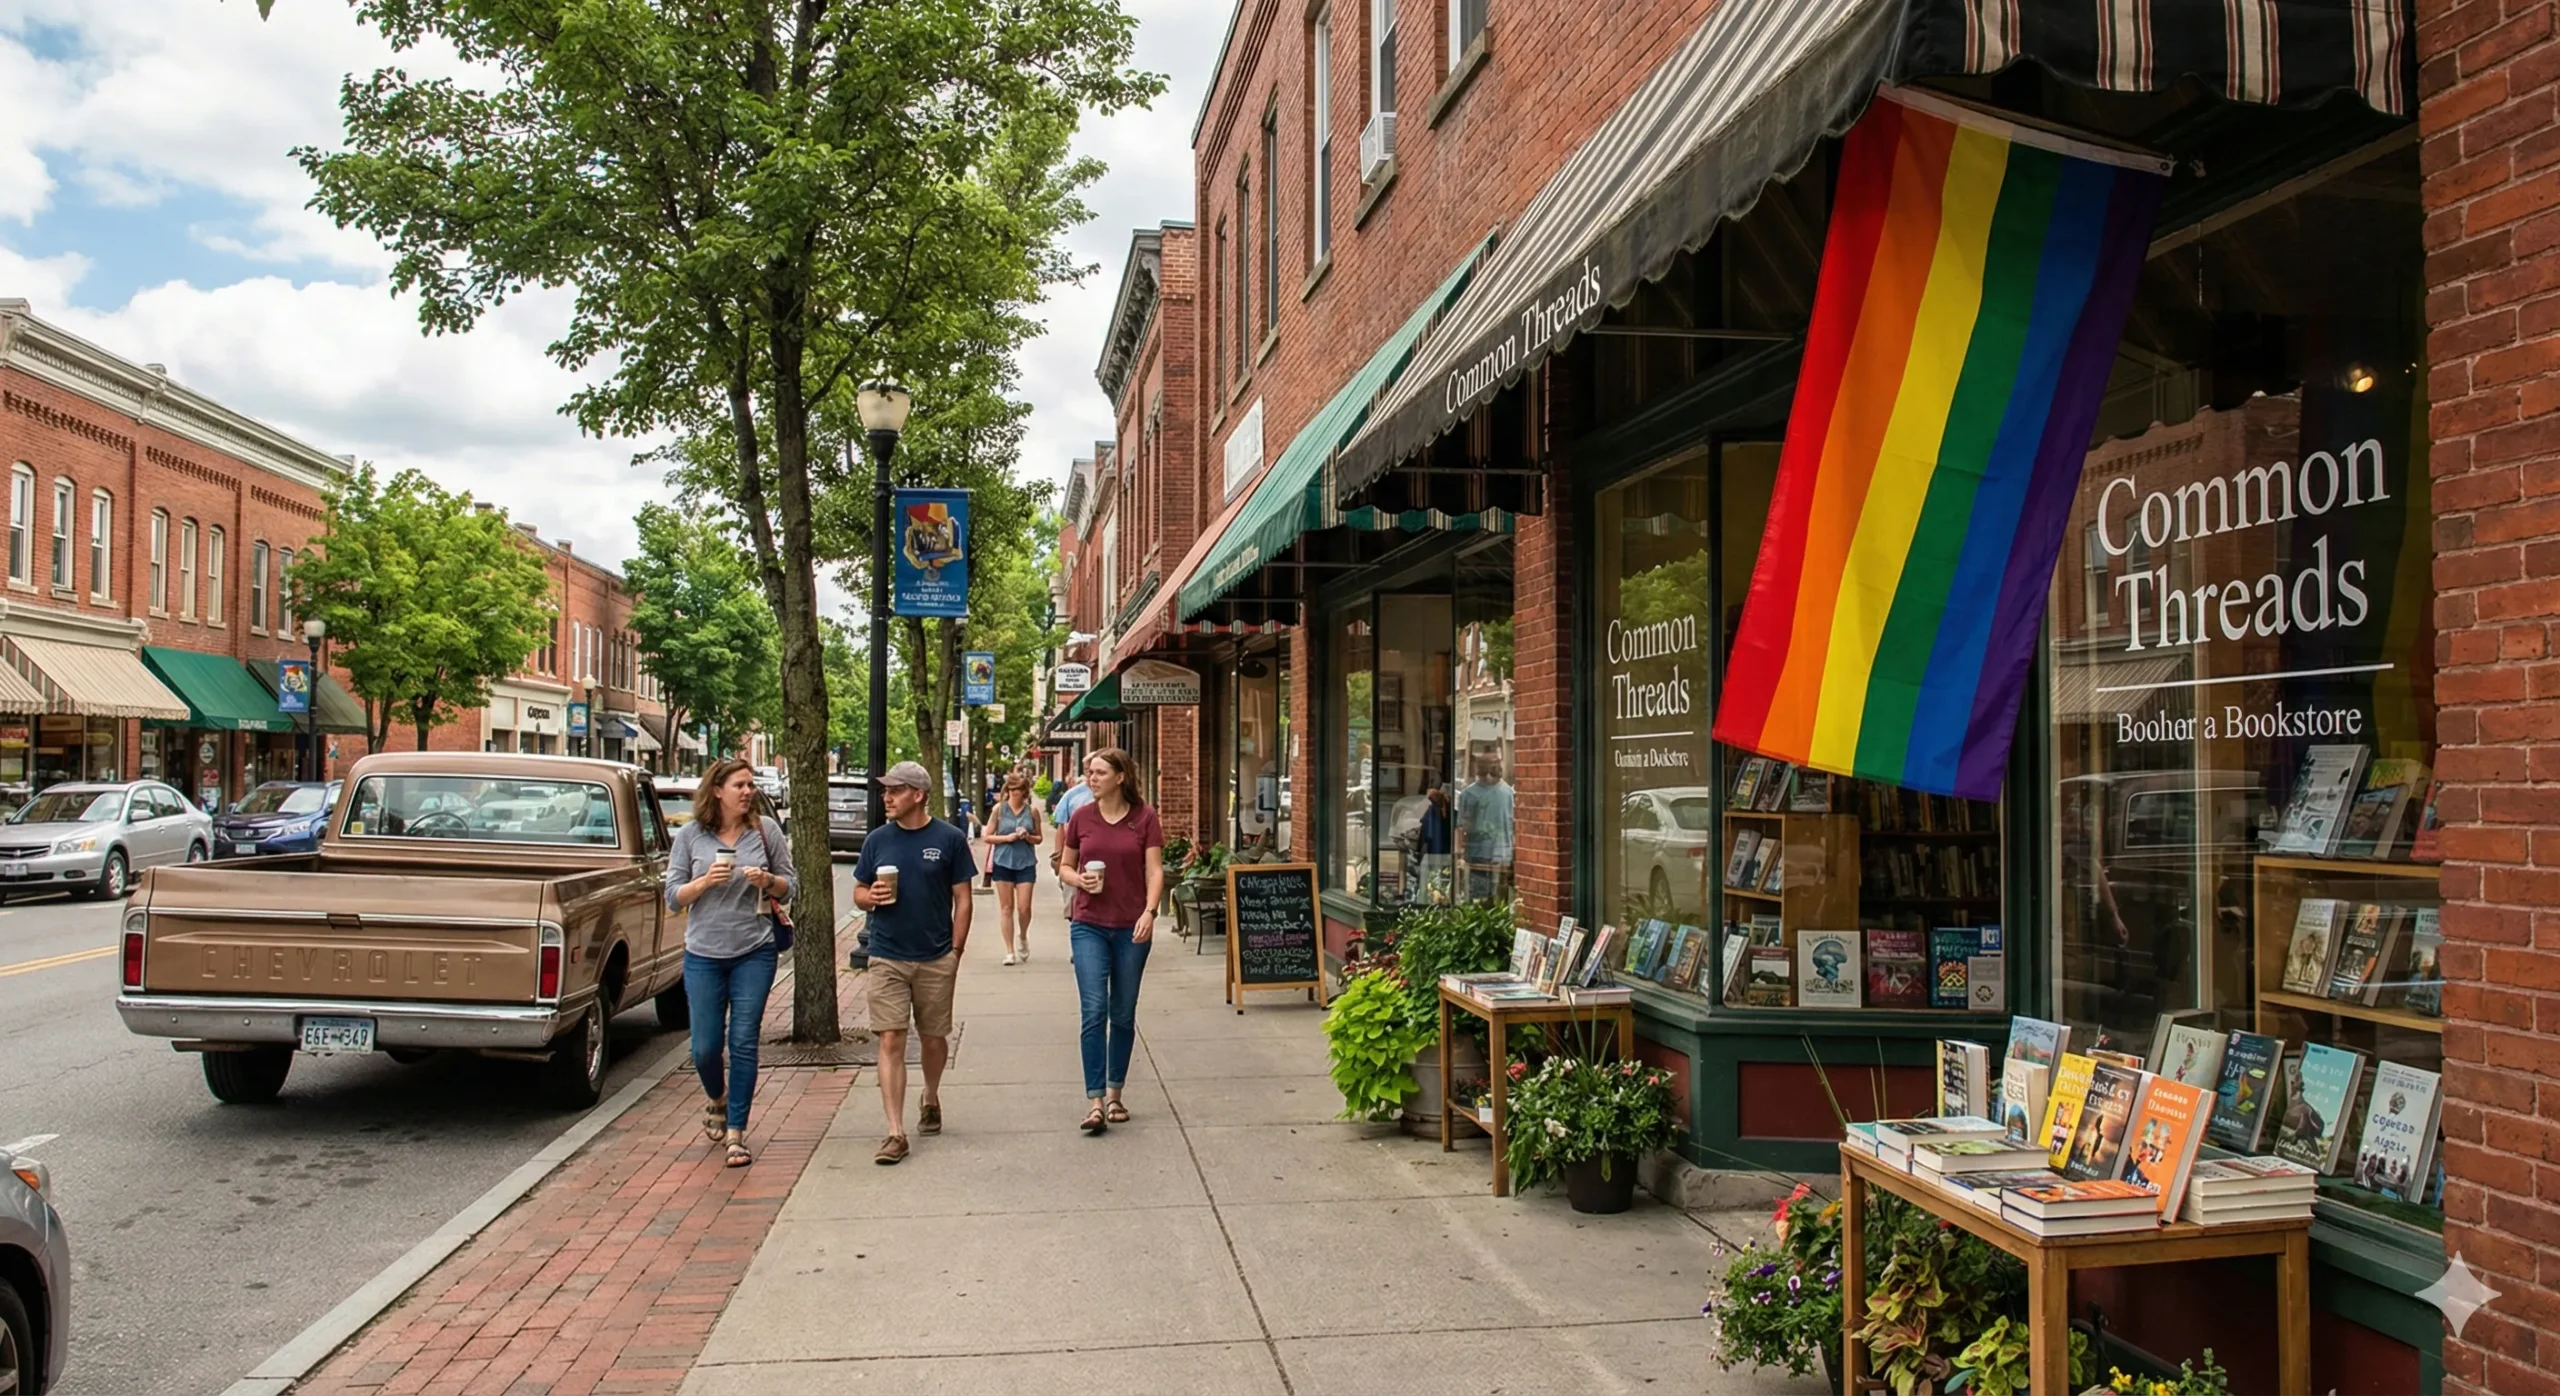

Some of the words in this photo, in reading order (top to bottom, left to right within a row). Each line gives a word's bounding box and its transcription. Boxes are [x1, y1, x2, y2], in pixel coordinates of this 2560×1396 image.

[1446, 335, 1516, 414] Common
[1521, 255, 1601, 359] Threads
[2097, 438, 2391, 556] Common
[2115, 534, 2369, 652] Threads
[1608, 613, 1698, 665] Common
[1612, 664, 1690, 720] Threads
[2204, 715, 2218, 739] a
[2223, 701, 2363, 738] Bookstore
[201, 944, 482, 986] CHEVROLET
